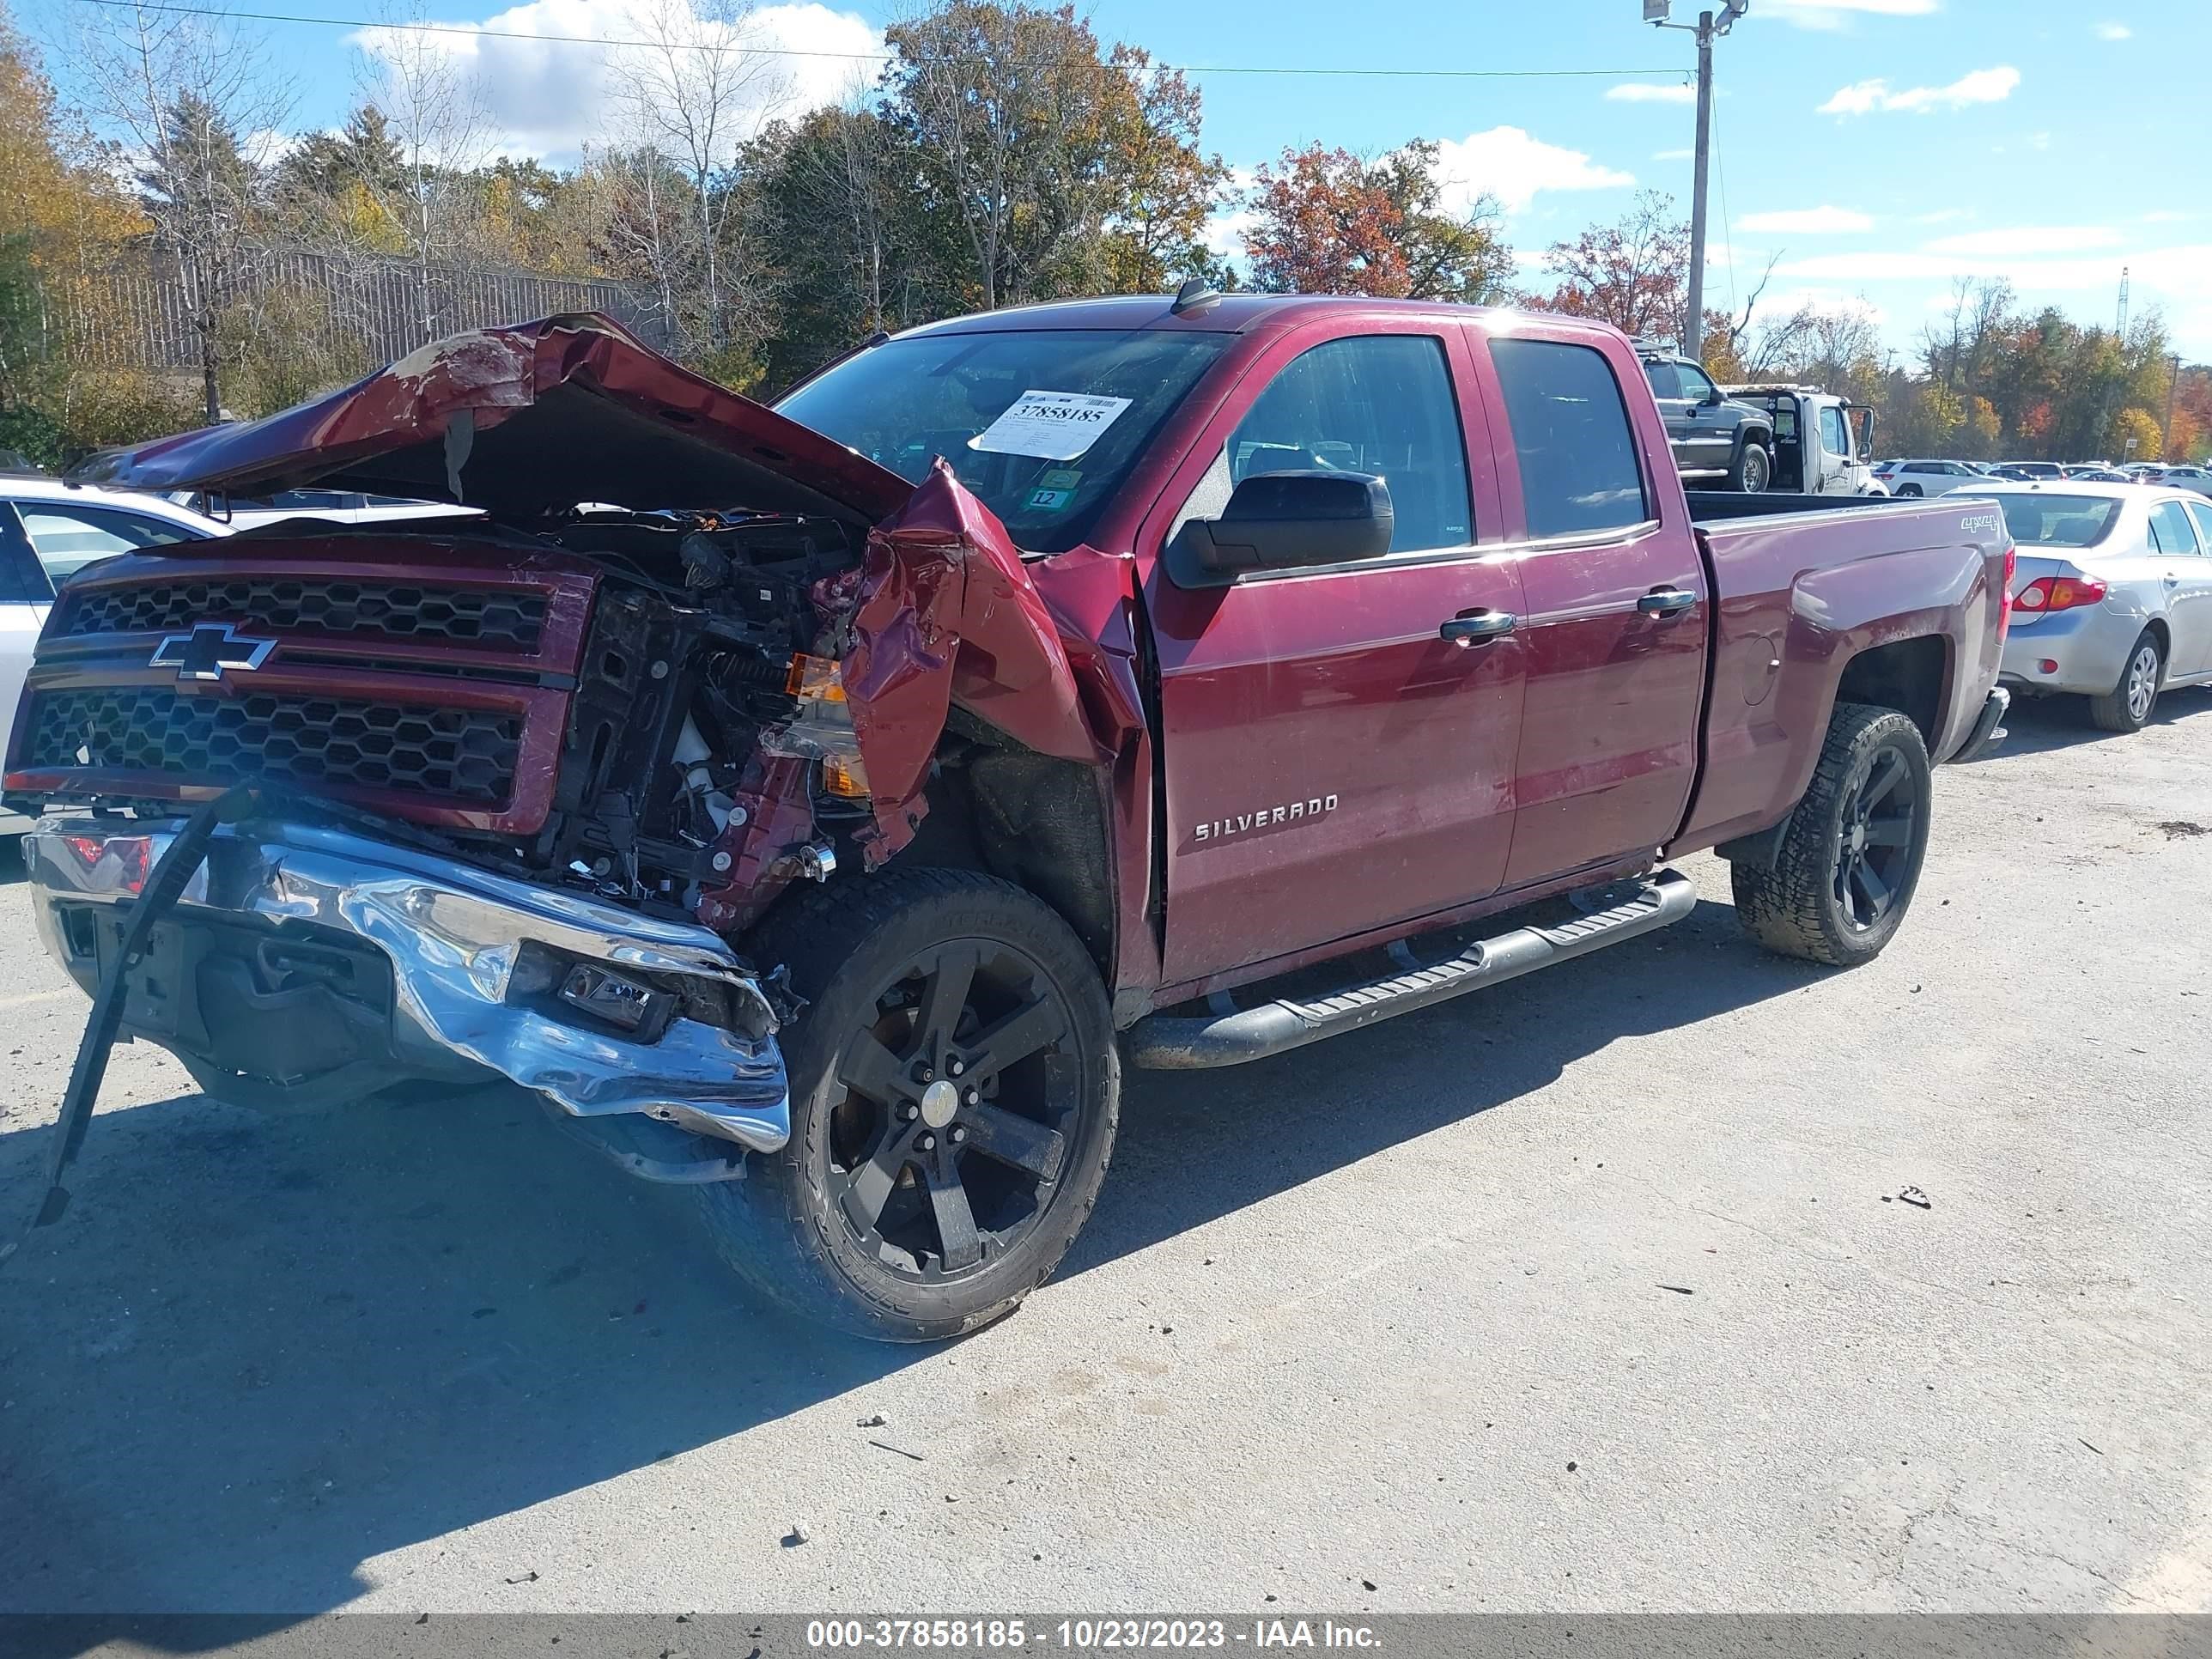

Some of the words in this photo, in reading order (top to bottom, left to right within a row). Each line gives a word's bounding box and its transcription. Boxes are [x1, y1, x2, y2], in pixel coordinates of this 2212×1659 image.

[1013, 405, 1105, 422] 37858185
[1032, 492, 1056, 505] 12
[1194, 793, 1338, 842] SILVERADO
